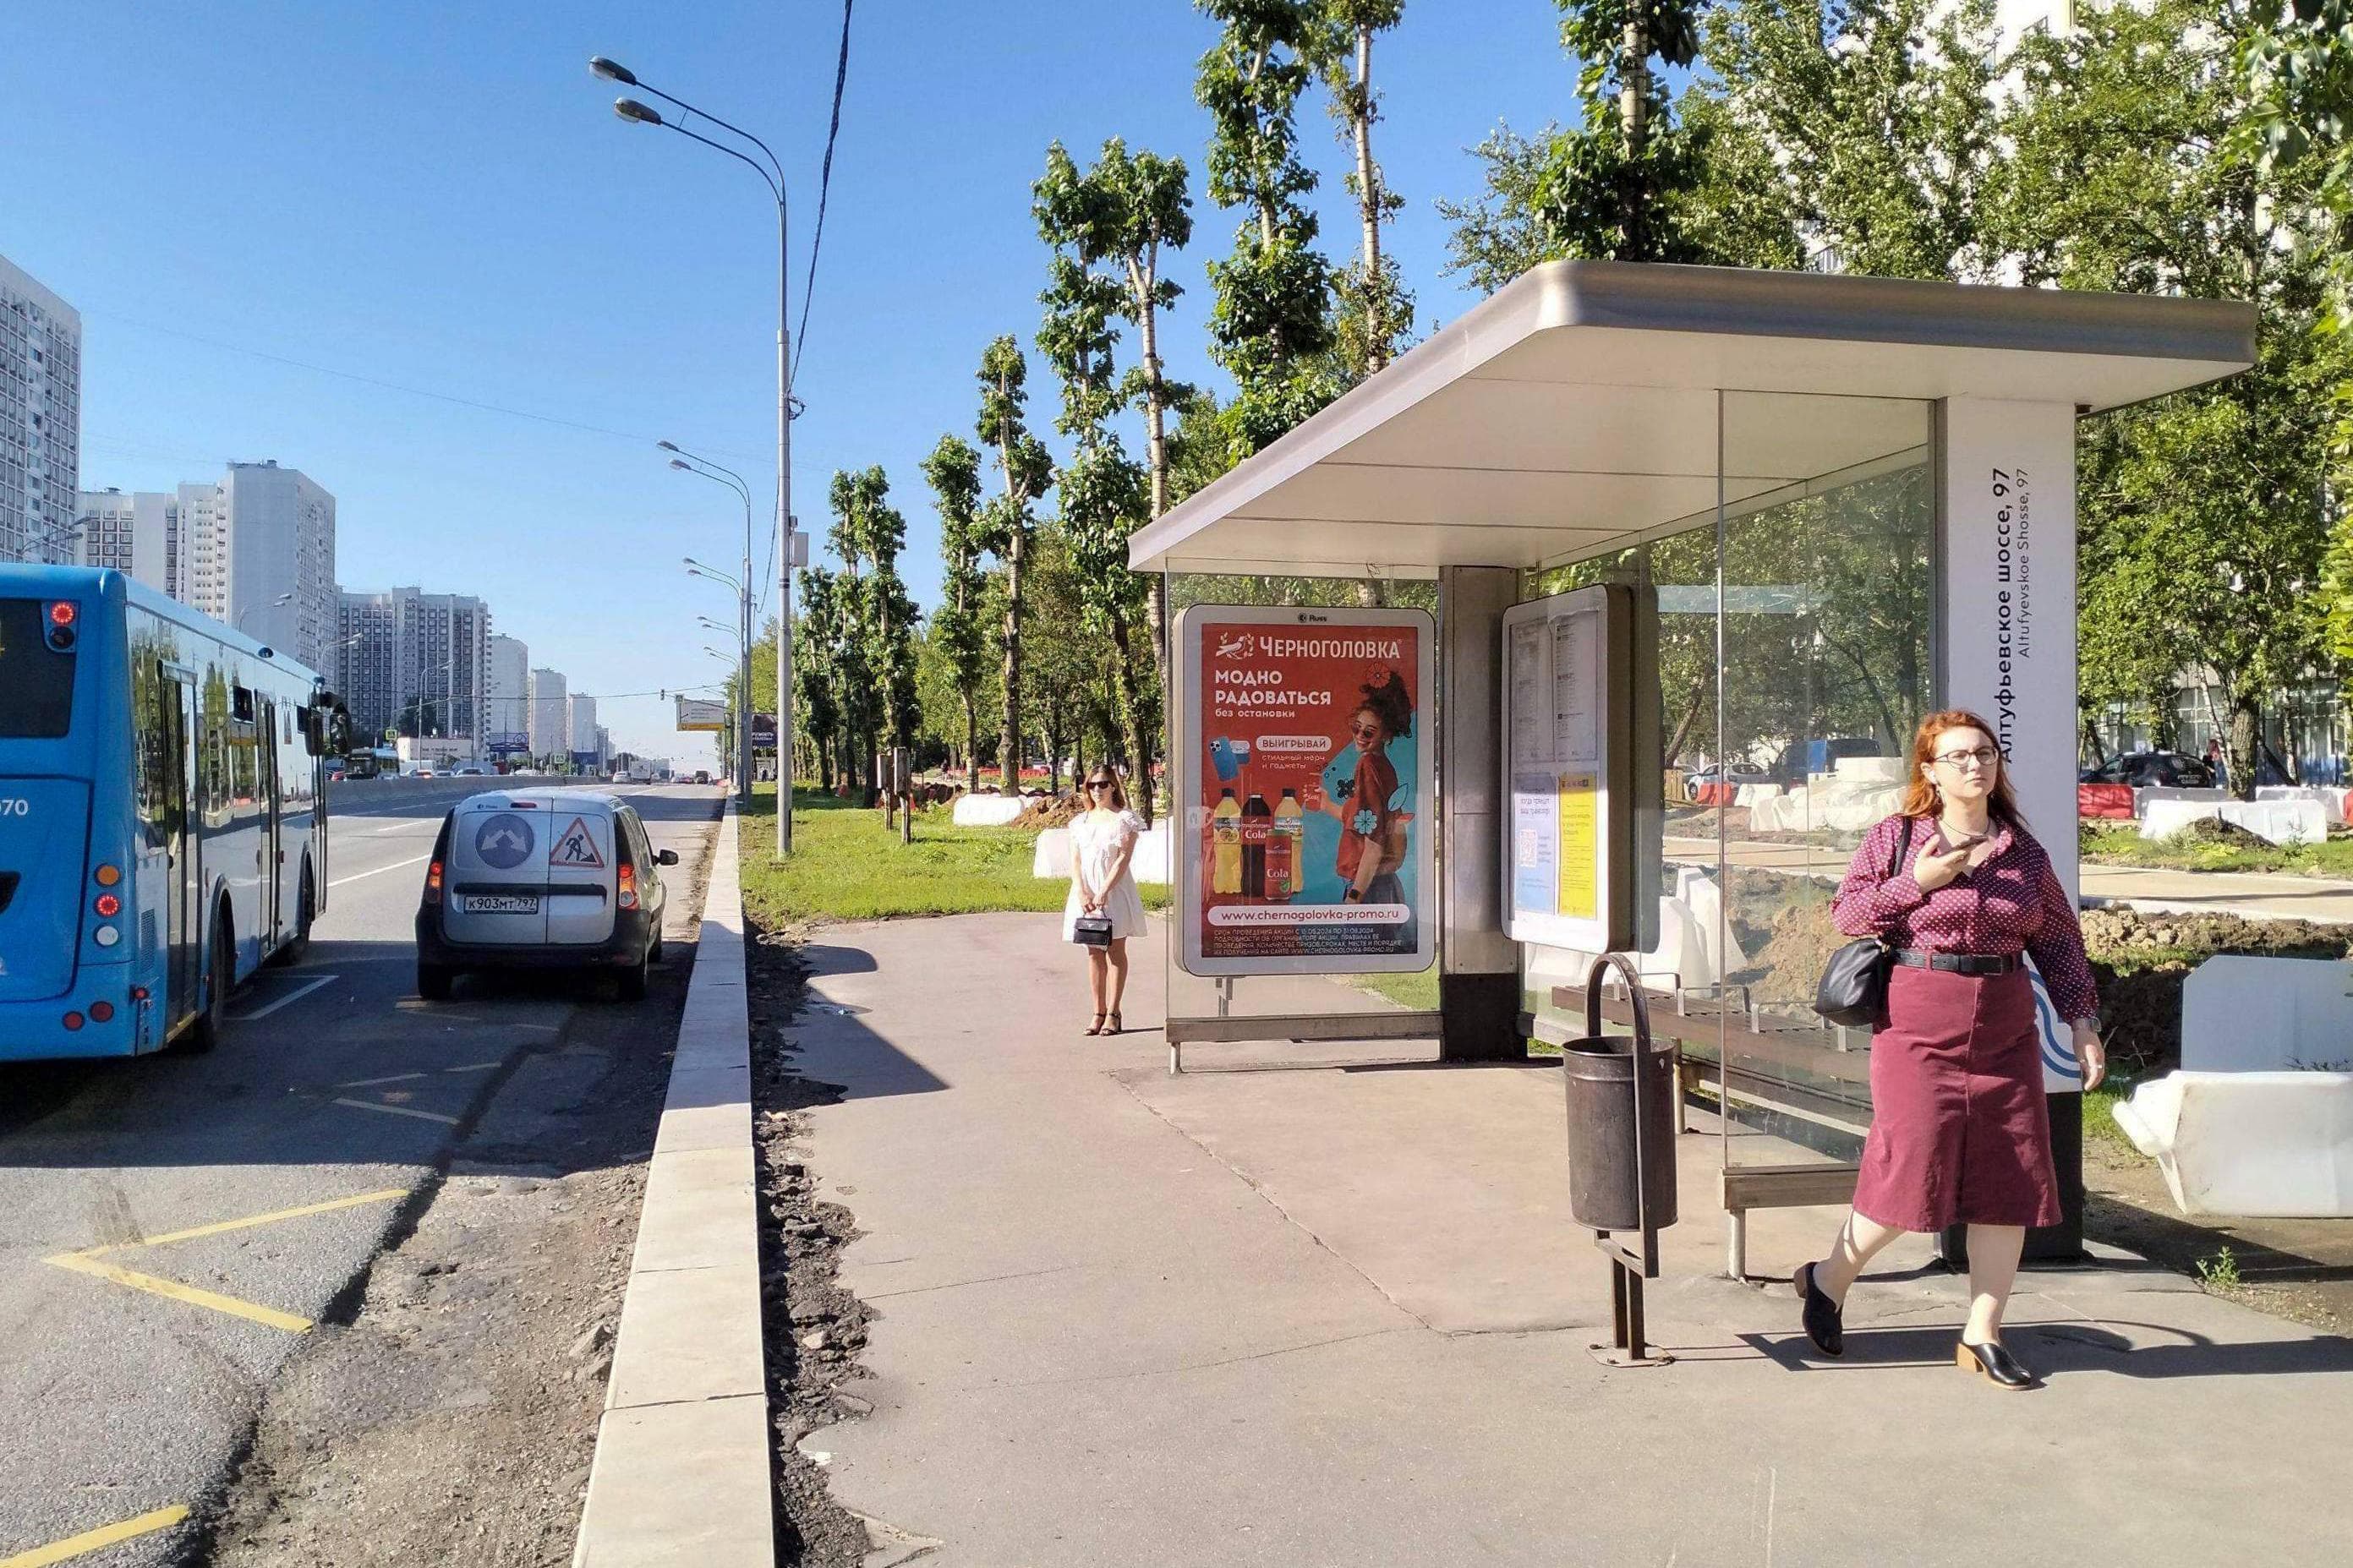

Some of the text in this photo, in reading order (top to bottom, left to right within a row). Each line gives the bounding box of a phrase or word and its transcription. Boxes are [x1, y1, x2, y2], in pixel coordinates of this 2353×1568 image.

[2016, 467, 2033, 658] Altufyevskoe Shosse, 97
[1992, 467, 2016, 764] Алтуфьевское шоссе, 97
[1260, 636, 1400, 658] ЧЕРНОГОЛОВКА
[1215, 669, 1283, 686] МОДНО
[1215, 691, 1331, 706] РАДОВАТЬСЯ
[1215, 708, 1295, 718] без остановки
[1262, 737, 1326, 749] ВЫИГРЫВАЙ
[0, 799, 28, 817] 70
[1245, 830, 1267, 839] Cola
[1267, 867, 1289, 878] Cola
[516, 898, 534, 907] 797
[1222, 909, 1398, 922] www.chernogolovka-promo.ru
